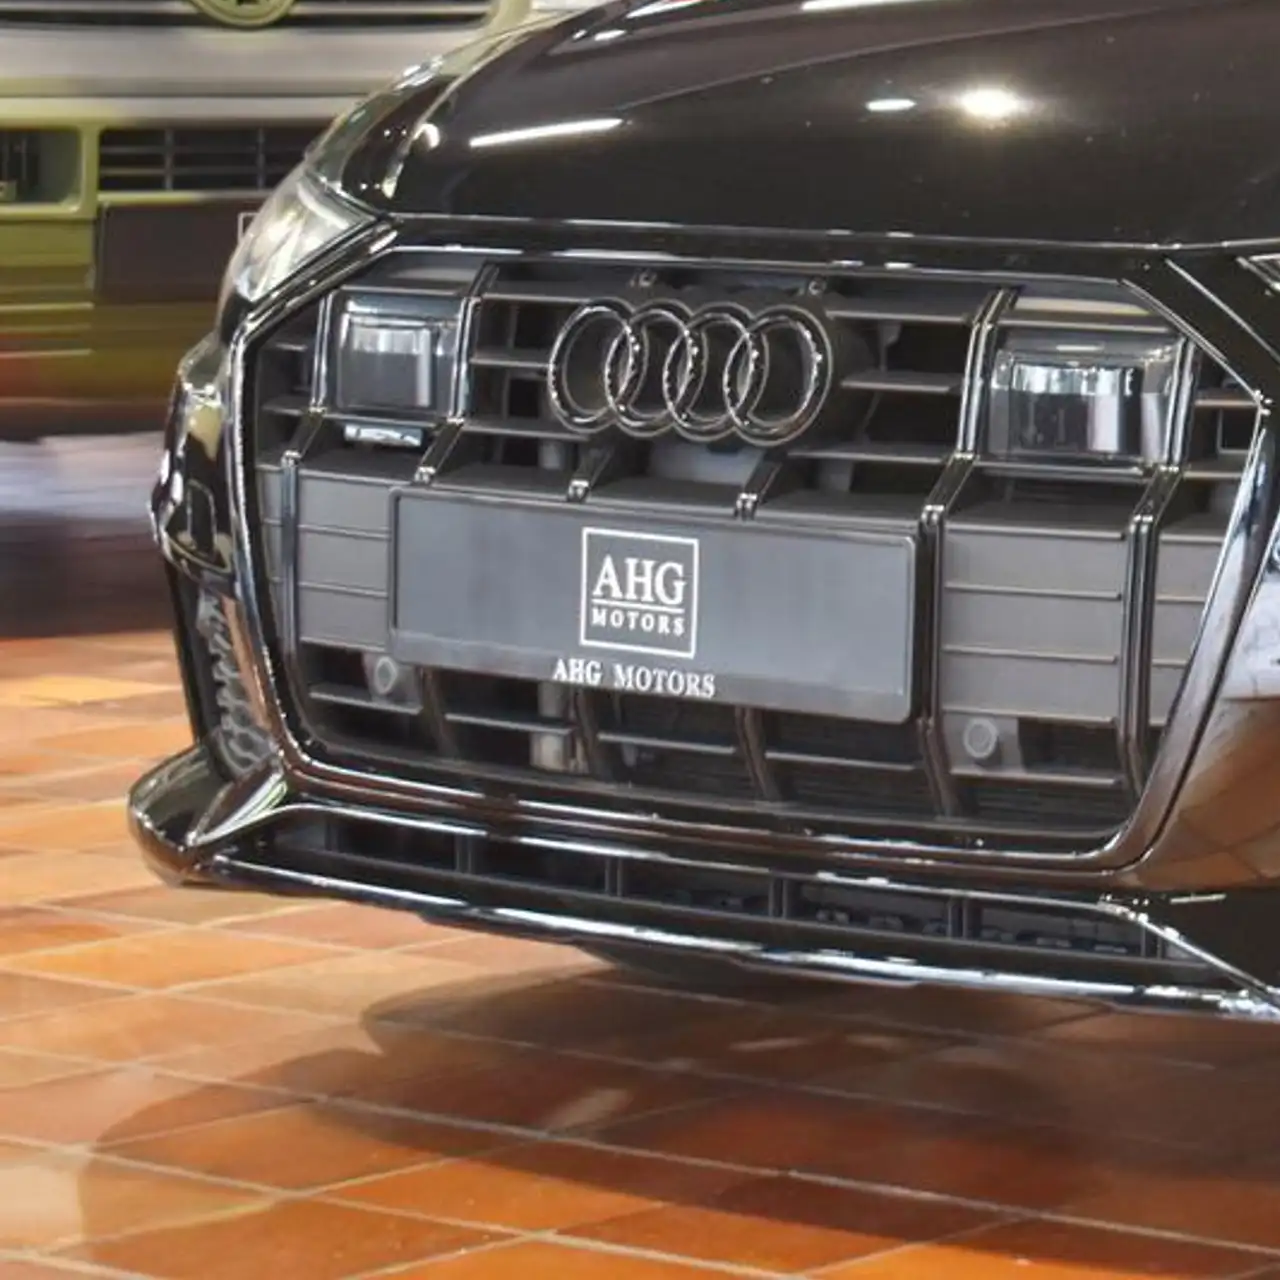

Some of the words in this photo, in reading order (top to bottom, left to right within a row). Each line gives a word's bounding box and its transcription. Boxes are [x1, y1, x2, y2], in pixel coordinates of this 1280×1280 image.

[592, 554, 687, 605] AHG
[591, 607, 684, 637] MOTORS
[552, 657, 602, 687] AHG
[613, 663, 716, 699] MOTORS
